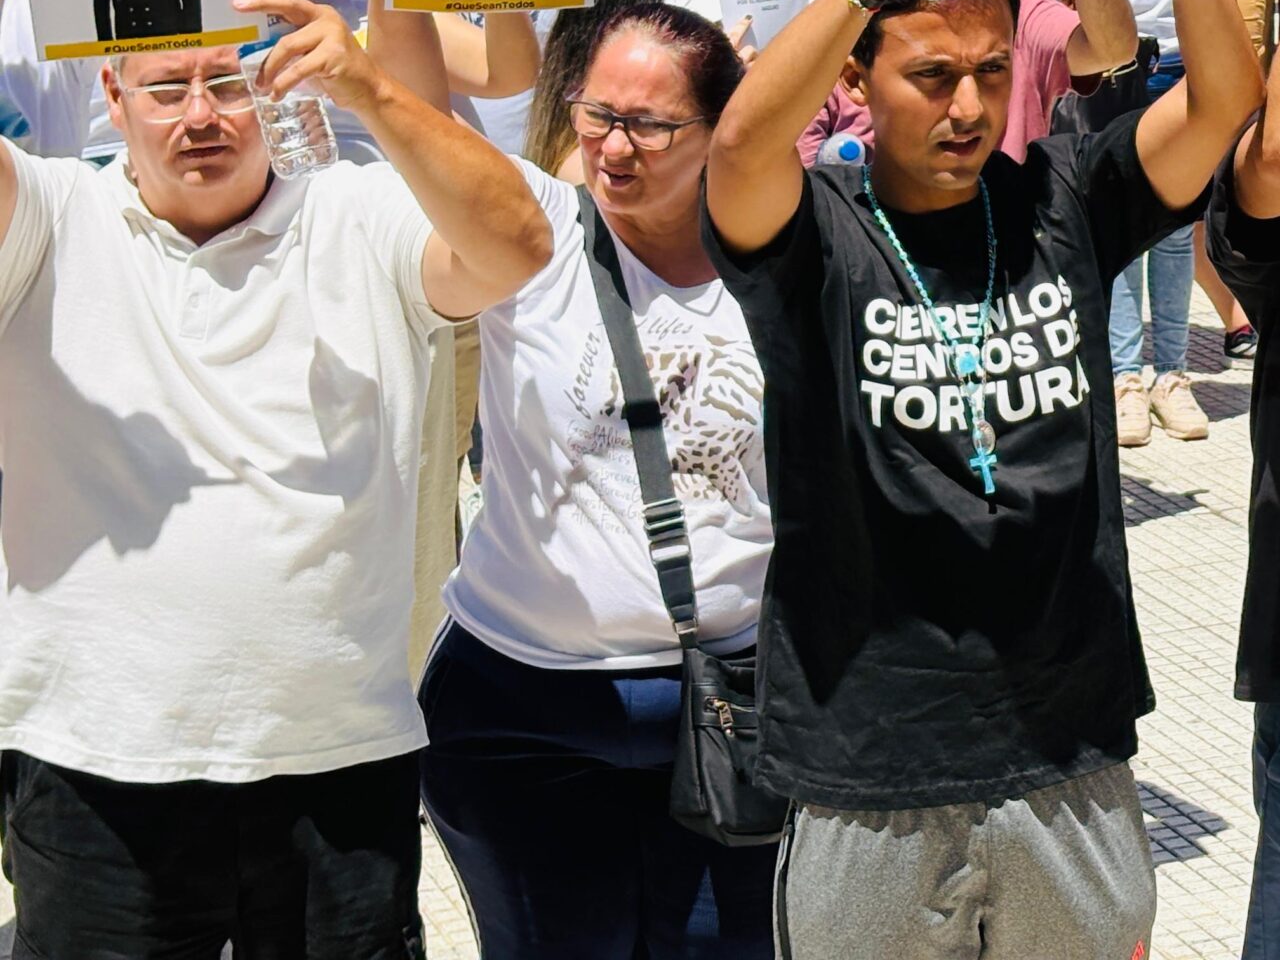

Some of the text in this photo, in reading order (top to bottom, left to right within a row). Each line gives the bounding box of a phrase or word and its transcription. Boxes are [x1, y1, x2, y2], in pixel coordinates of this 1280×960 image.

[446, 0, 534, 10] #QueSeanTodos
[104, 38, 203, 54] #QueSeanTodos
[1008, 274, 1073, 326] LOS
